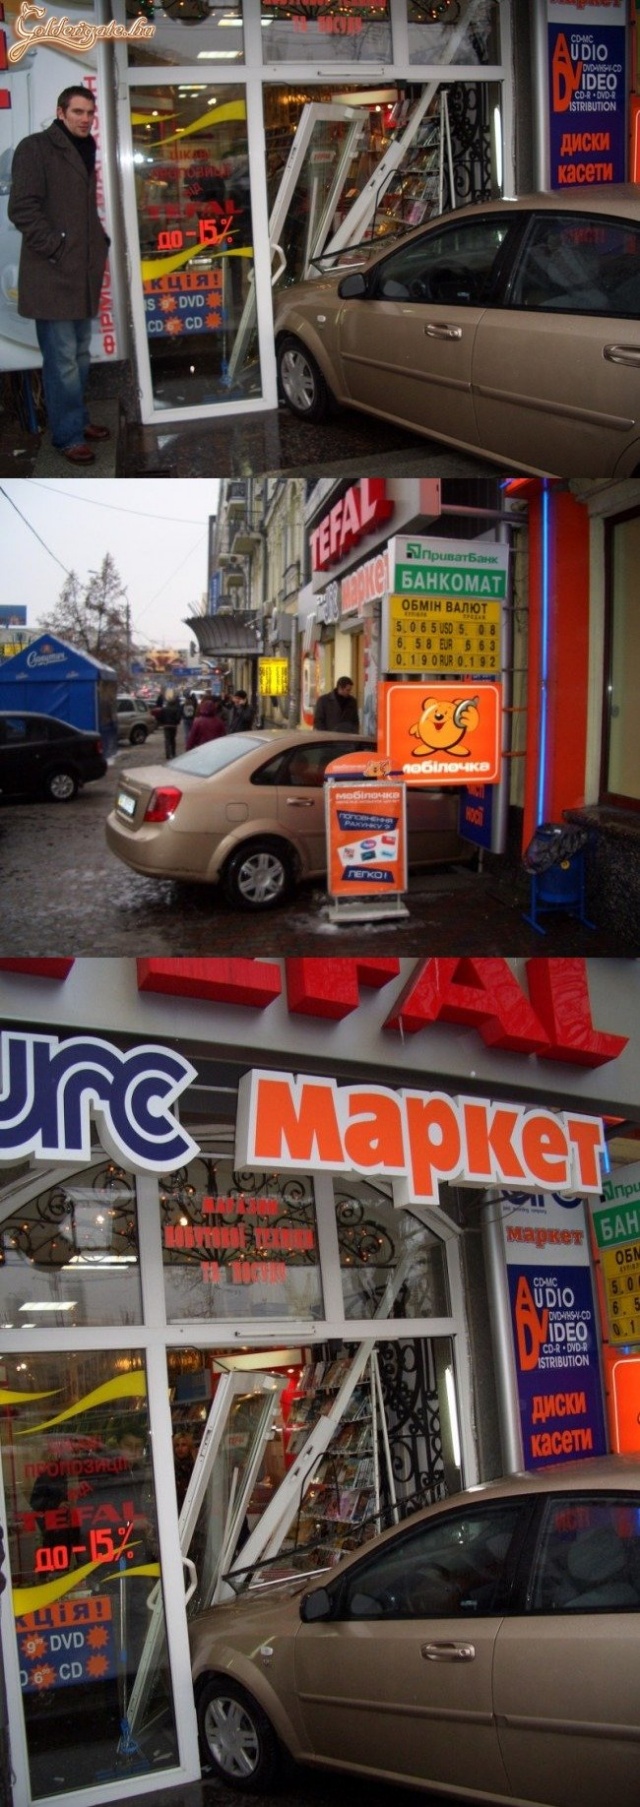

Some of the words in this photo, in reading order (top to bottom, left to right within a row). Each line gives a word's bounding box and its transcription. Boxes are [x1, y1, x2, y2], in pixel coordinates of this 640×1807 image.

[178, 294, 205, 308] DVD
[185, 316, 203, 330] CD
[310, 477, 378, 571] TEFAL
[422, 549, 498, 564] ПриватБанк
[402, 570, 502, 594] БАНКОМАТ
[402, 598, 442, 613] ОБМІН
[446, 600, 488, 615] ВАЛЮТ
[238, 1069, 602, 1199] маркет
[506, 1225, 584, 1249] маркет
[16, 1500, 147, 1532] TEFAL
[50, 1632, 85, 1651] DVD
[60, 1662, 83, 1680] CD
